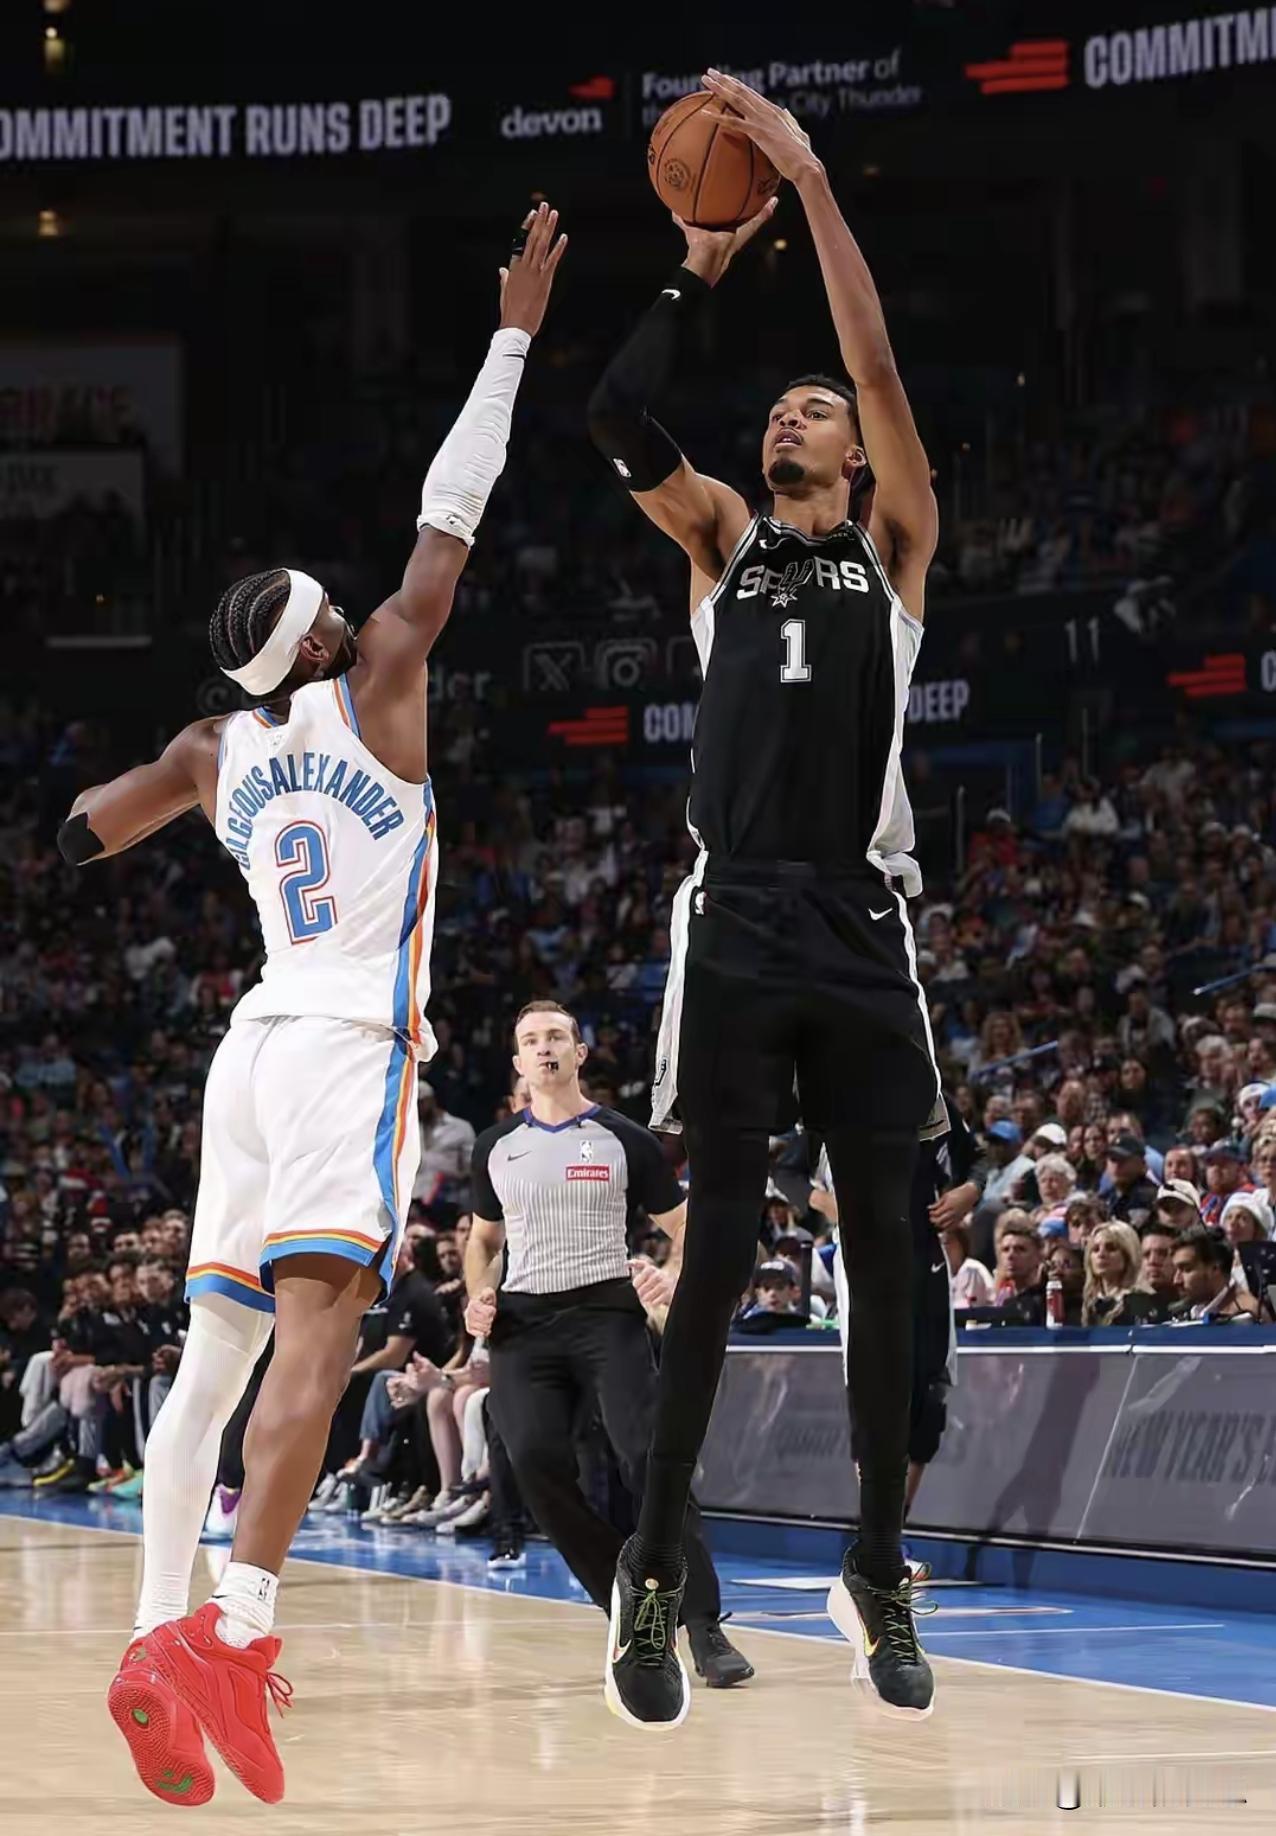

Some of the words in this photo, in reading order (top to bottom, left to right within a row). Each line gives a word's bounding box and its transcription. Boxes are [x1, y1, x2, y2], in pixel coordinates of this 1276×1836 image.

[768, 59, 867, 88] Partner
[873, 43, 902, 80] of
[1084, 5, 1276, 89] COMMITM
[837, 83, 921, 112] Thunder
[245, 102, 349, 156] RUNS
[358, 93, 451, 150] DEEP
[500, 105, 602, 139] devon
[780, 618, 812, 683] 1
[906, 681, 970, 724] DEEP
[274, 819, 338, 945] 2
[567, 1167, 609, 1179] Emirates
